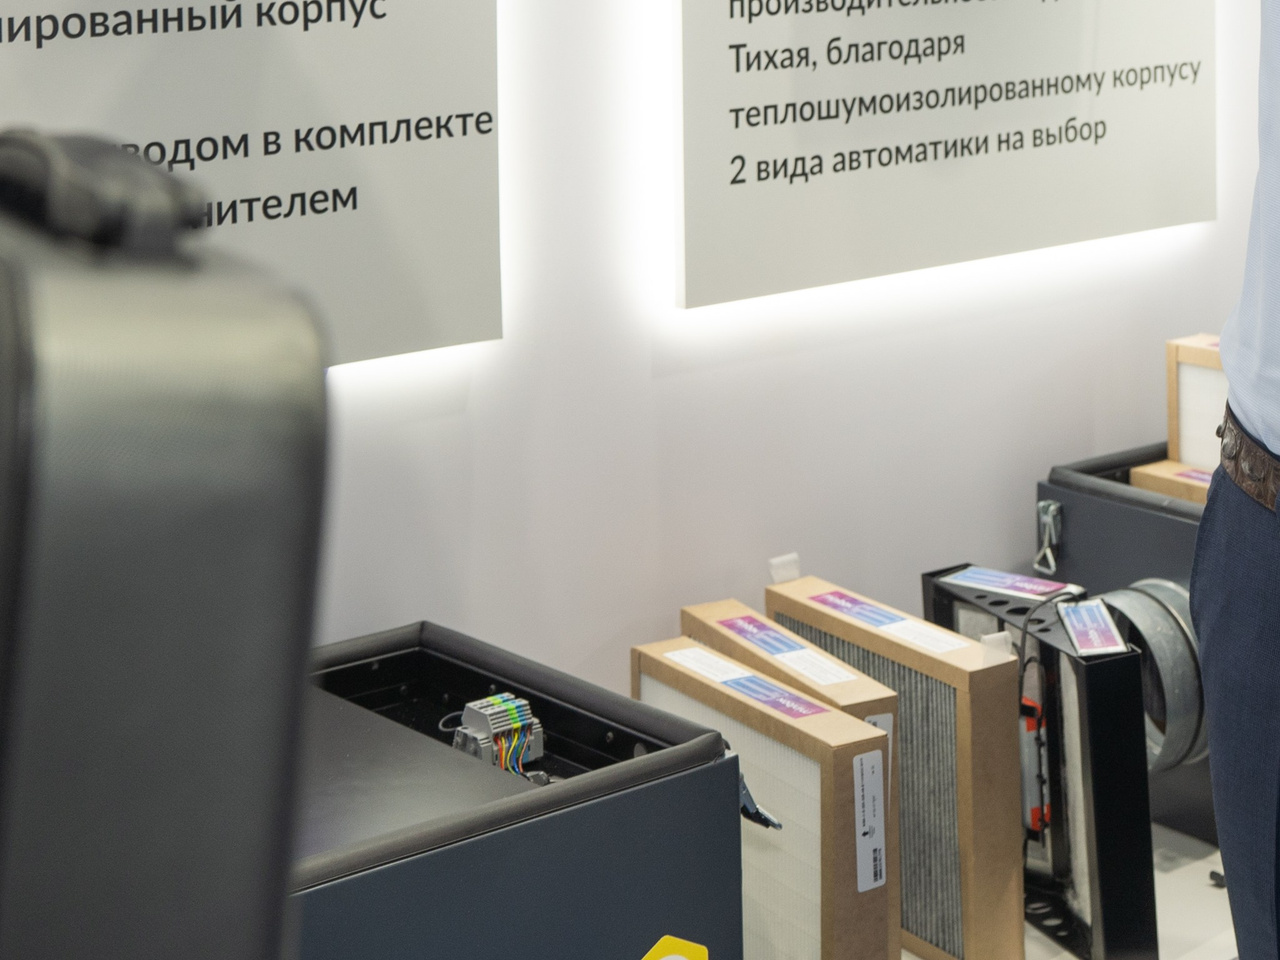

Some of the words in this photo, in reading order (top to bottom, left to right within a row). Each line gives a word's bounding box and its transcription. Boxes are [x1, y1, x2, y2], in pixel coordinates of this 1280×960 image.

[728, 43, 817, 74] Тихая,
[826, 36, 965, 66] благодаря
[729, 71, 1106, 129] теплошумоизолированному
[1112, 60, 1201, 91] корпусу
[263, 130, 282, 157] в
[295, 111, 493, 153] комплекте
[730, 155, 746, 185] 2
[757, 153, 823, 184] вида
[832, 134, 989, 173] автоматики
[997, 129, 1024, 152] на
[1033, 116, 1107, 145] выбор
